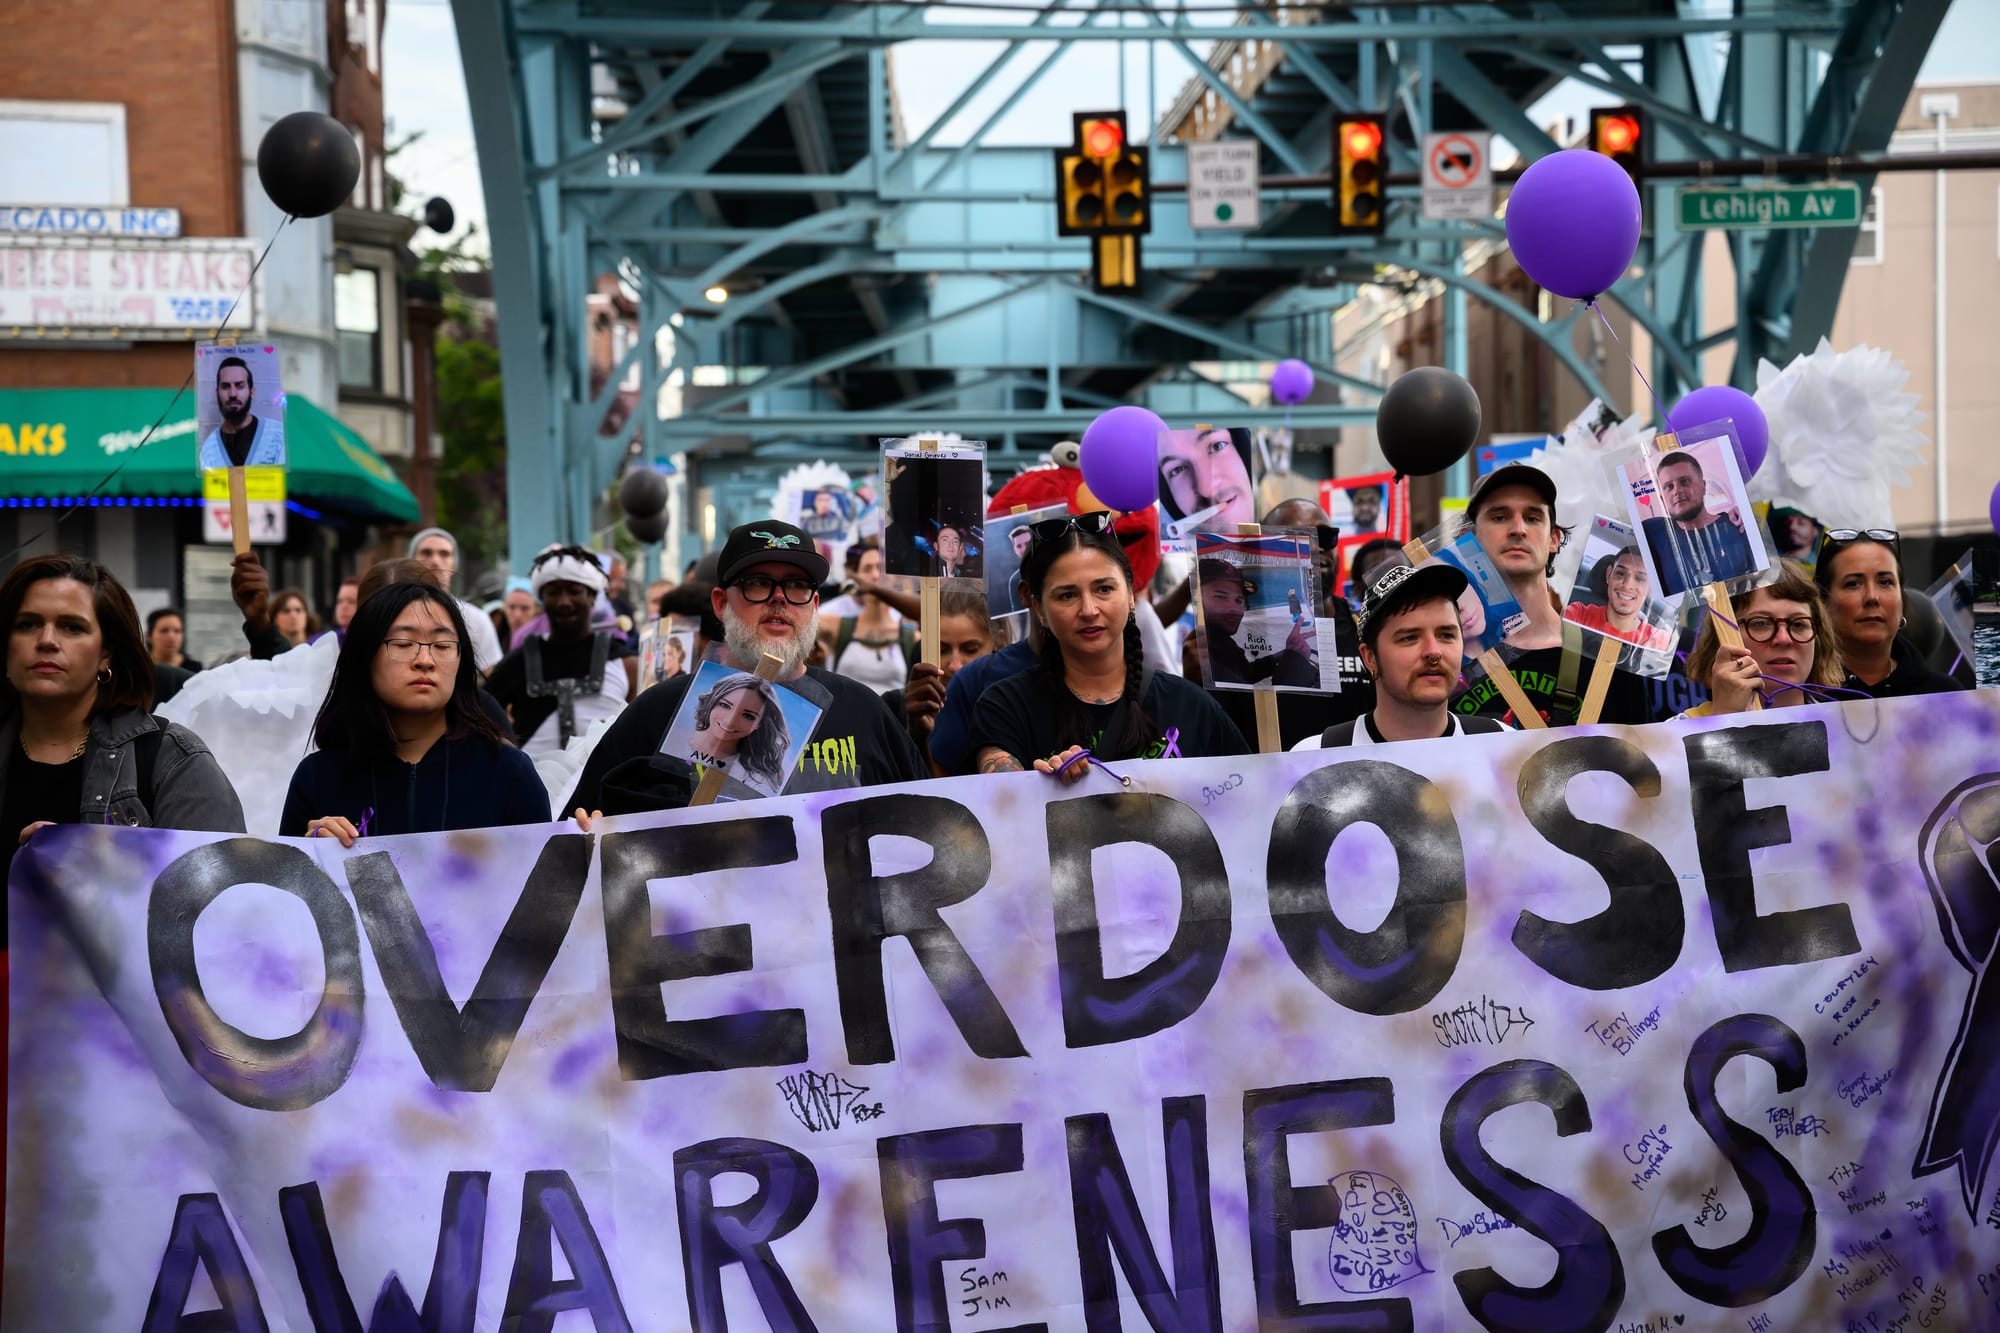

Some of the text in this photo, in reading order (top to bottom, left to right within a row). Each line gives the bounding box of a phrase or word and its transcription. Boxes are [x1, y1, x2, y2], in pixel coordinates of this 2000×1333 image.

[1201, 166, 1246, 182] YIELD
[1700, 189, 1836, 224] Lehigh Av
[0, 250, 251, 292] EESE STEAKS
[1244, 642, 1273, 651] Landis
[1247, 633, 1266, 644] Rich
[689, 750, 715, 766] AVA
[148, 721, 1861, 1112] OVERDOSE
[1584, 1011, 1633, 1046] Terry
[1611, 1005, 1664, 1056] Billinger
[141, 1013, 1817, 1333] AWARENESS
[960, 1267, 1008, 1293] SAM
[962, 1296, 1012, 1317] JIM
[1747, 1312, 1773, 1333] Hill
